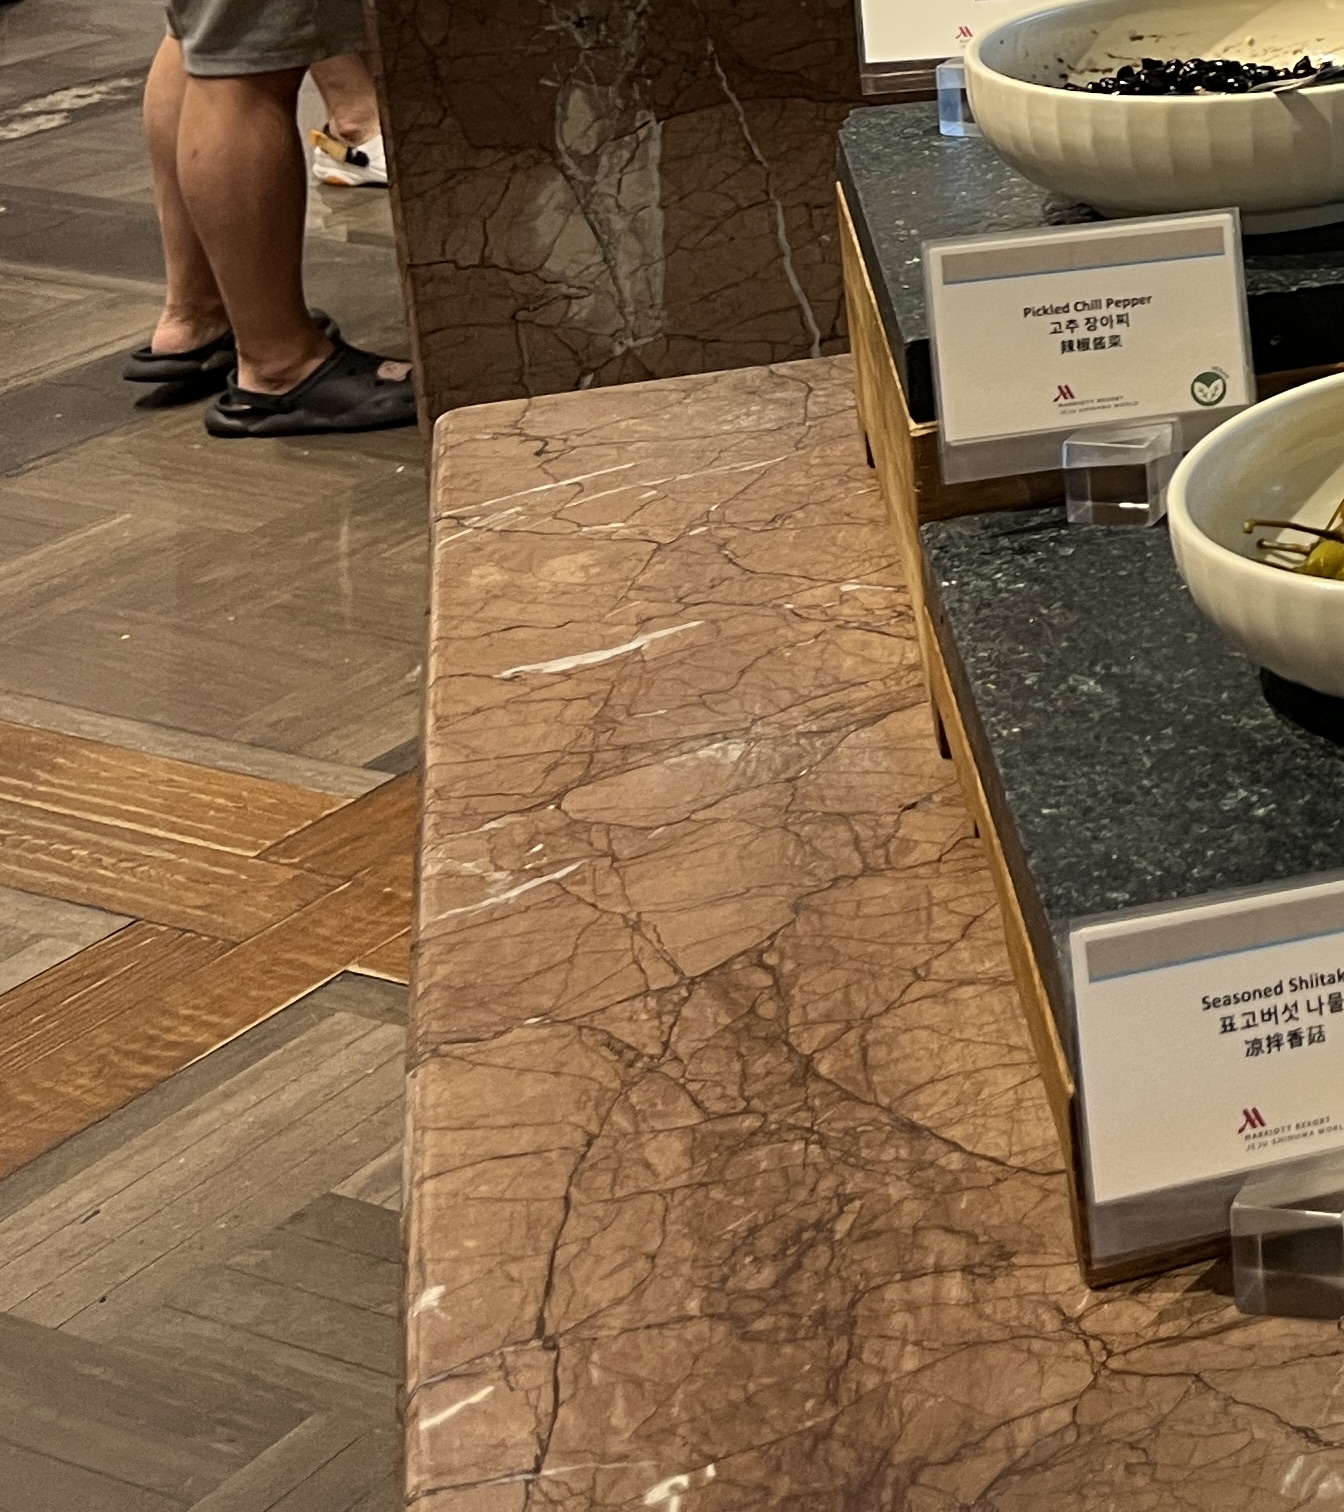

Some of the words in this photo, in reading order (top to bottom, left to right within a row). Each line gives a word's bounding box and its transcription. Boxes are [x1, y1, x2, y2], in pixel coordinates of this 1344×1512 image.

[1023, 301, 1071, 319] Pickled
[1106, 294, 1153, 310] Pepper
[1049, 320, 1080, 336] 고추
[1083, 313, 1131, 333] 장아찌
[1201, 979, 1284, 1011] Seasoned
[1219, 999, 1300, 1035] 표고버섯
[1306, 991, 1344, 1017] 나물
